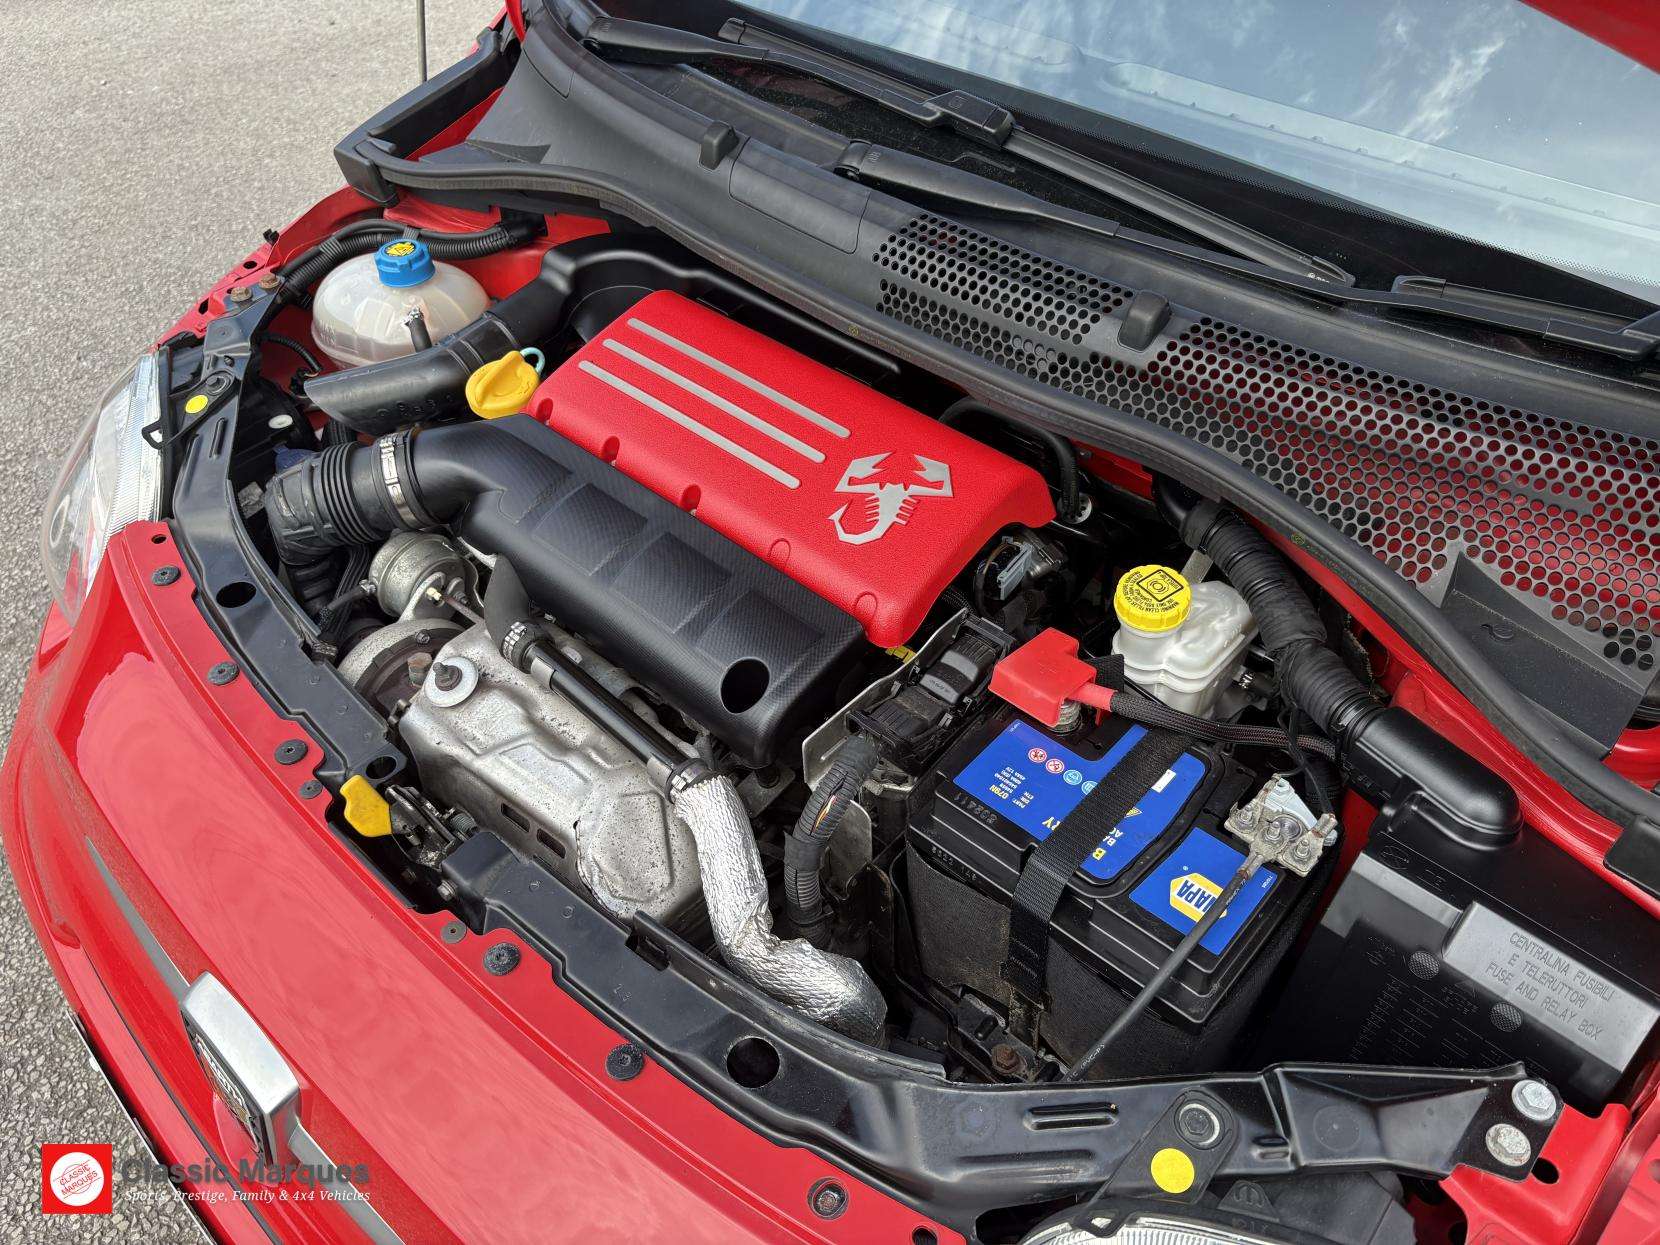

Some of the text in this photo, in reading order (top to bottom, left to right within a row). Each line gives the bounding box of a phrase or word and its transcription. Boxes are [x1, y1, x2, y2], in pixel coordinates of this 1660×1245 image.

[1485, 961, 1603, 1040] FUSE AND RELAY BOX
[1508, 953, 1588, 1009] E TELERUTTORI
[1509, 931, 1616, 1002] CENTRALINA FUSIBILI
